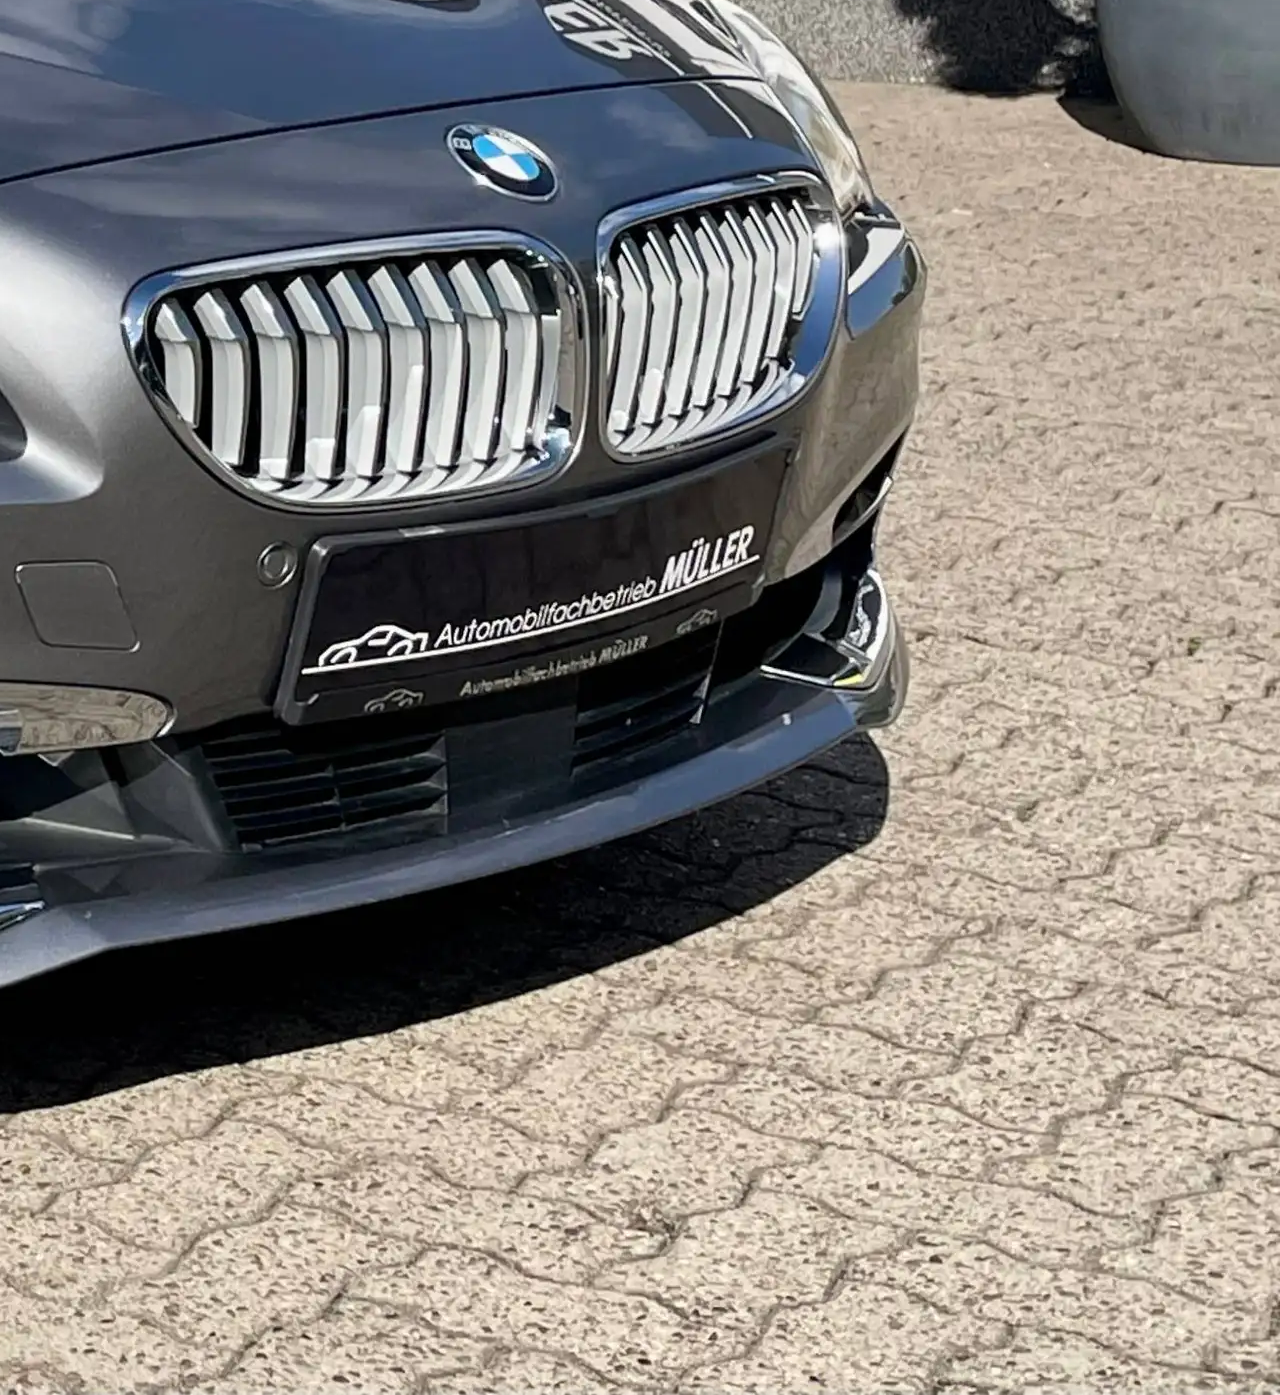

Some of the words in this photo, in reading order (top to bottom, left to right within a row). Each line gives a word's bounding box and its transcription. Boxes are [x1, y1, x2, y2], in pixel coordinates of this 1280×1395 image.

[434, 576, 656, 649] Automobilfachbetrieb
[660, 525, 756, 594] MÜLLER
[459, 654, 597, 697] Automobilfachbetrieb
[598, 634, 650, 665] MÜLLER
